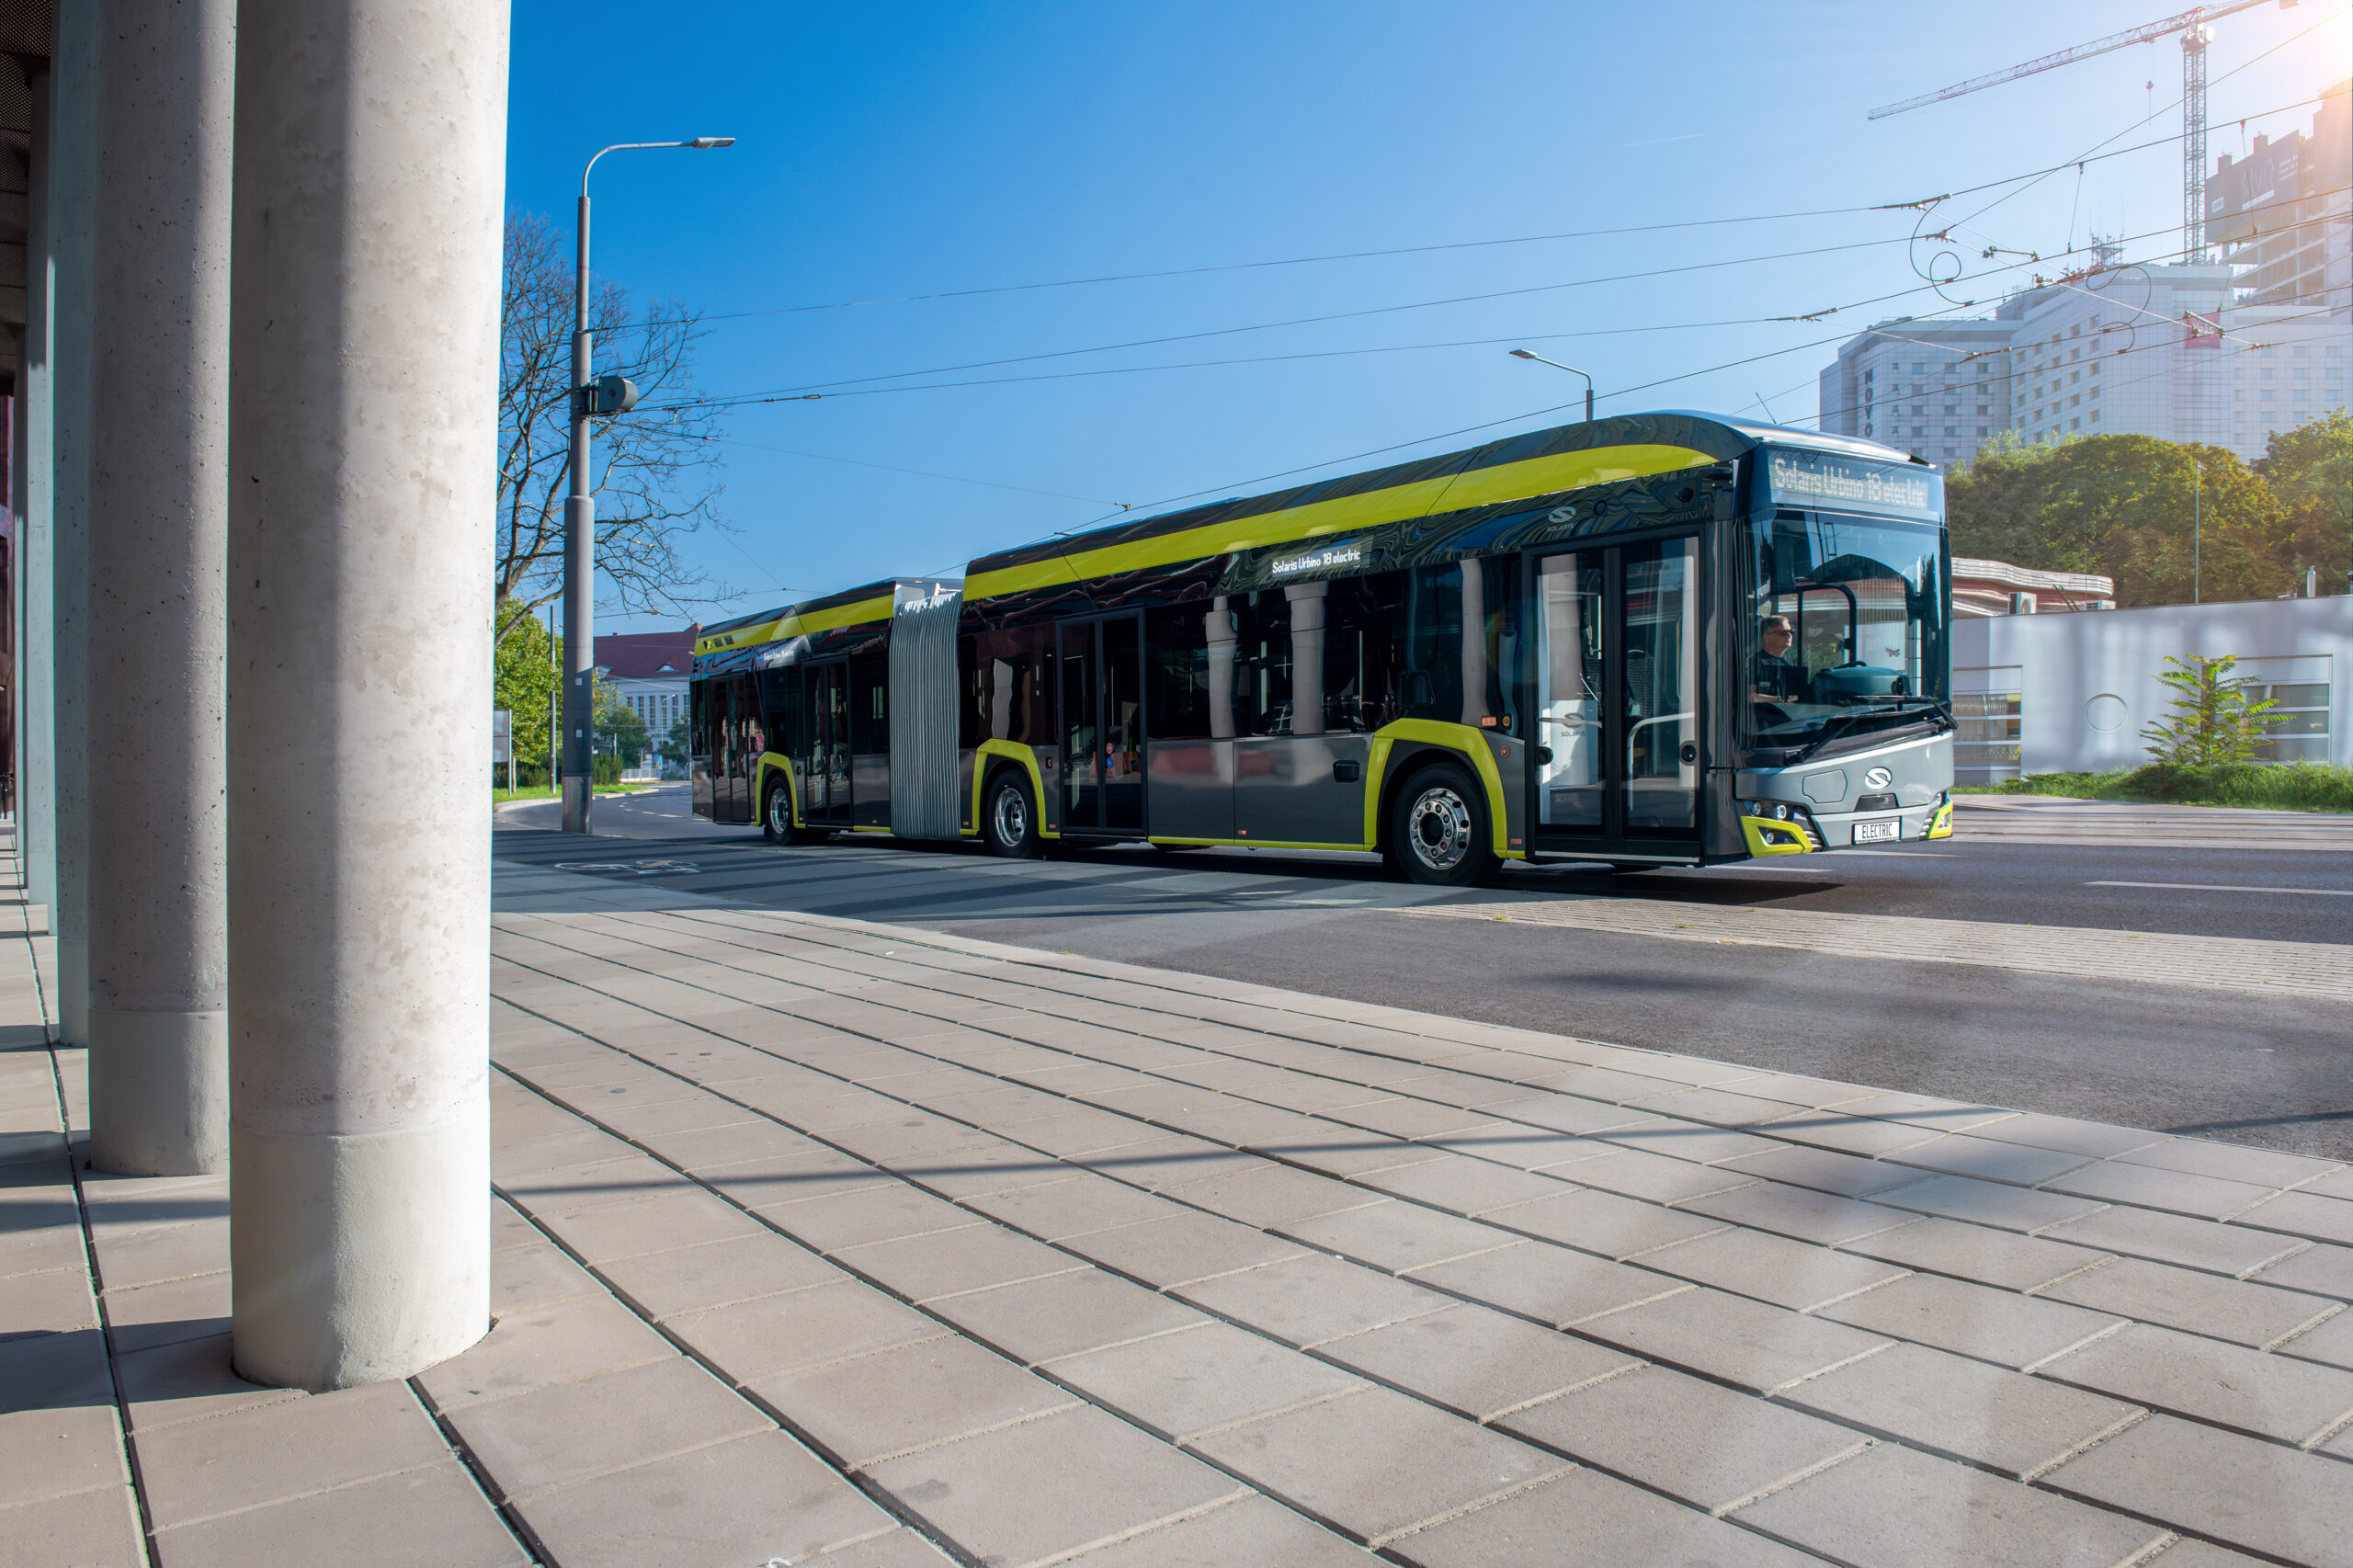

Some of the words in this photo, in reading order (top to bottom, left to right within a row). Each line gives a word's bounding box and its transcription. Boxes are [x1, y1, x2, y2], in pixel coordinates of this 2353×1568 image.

[1775, 458, 1822, 493] Solaris
[1824, 465, 1864, 498] Urbino
[1866, 472, 1881, 500] 18
[1547, 523, 1574, 532] SOLARIS
[1272, 560, 1297, 574] Solaris
[1298, 555, 1322, 570] Urbino
[1323, 552, 1332, 564] 18
[1333, 549, 1360, 563] electric
[1862, 823, 1893, 838] ELECTRIC
